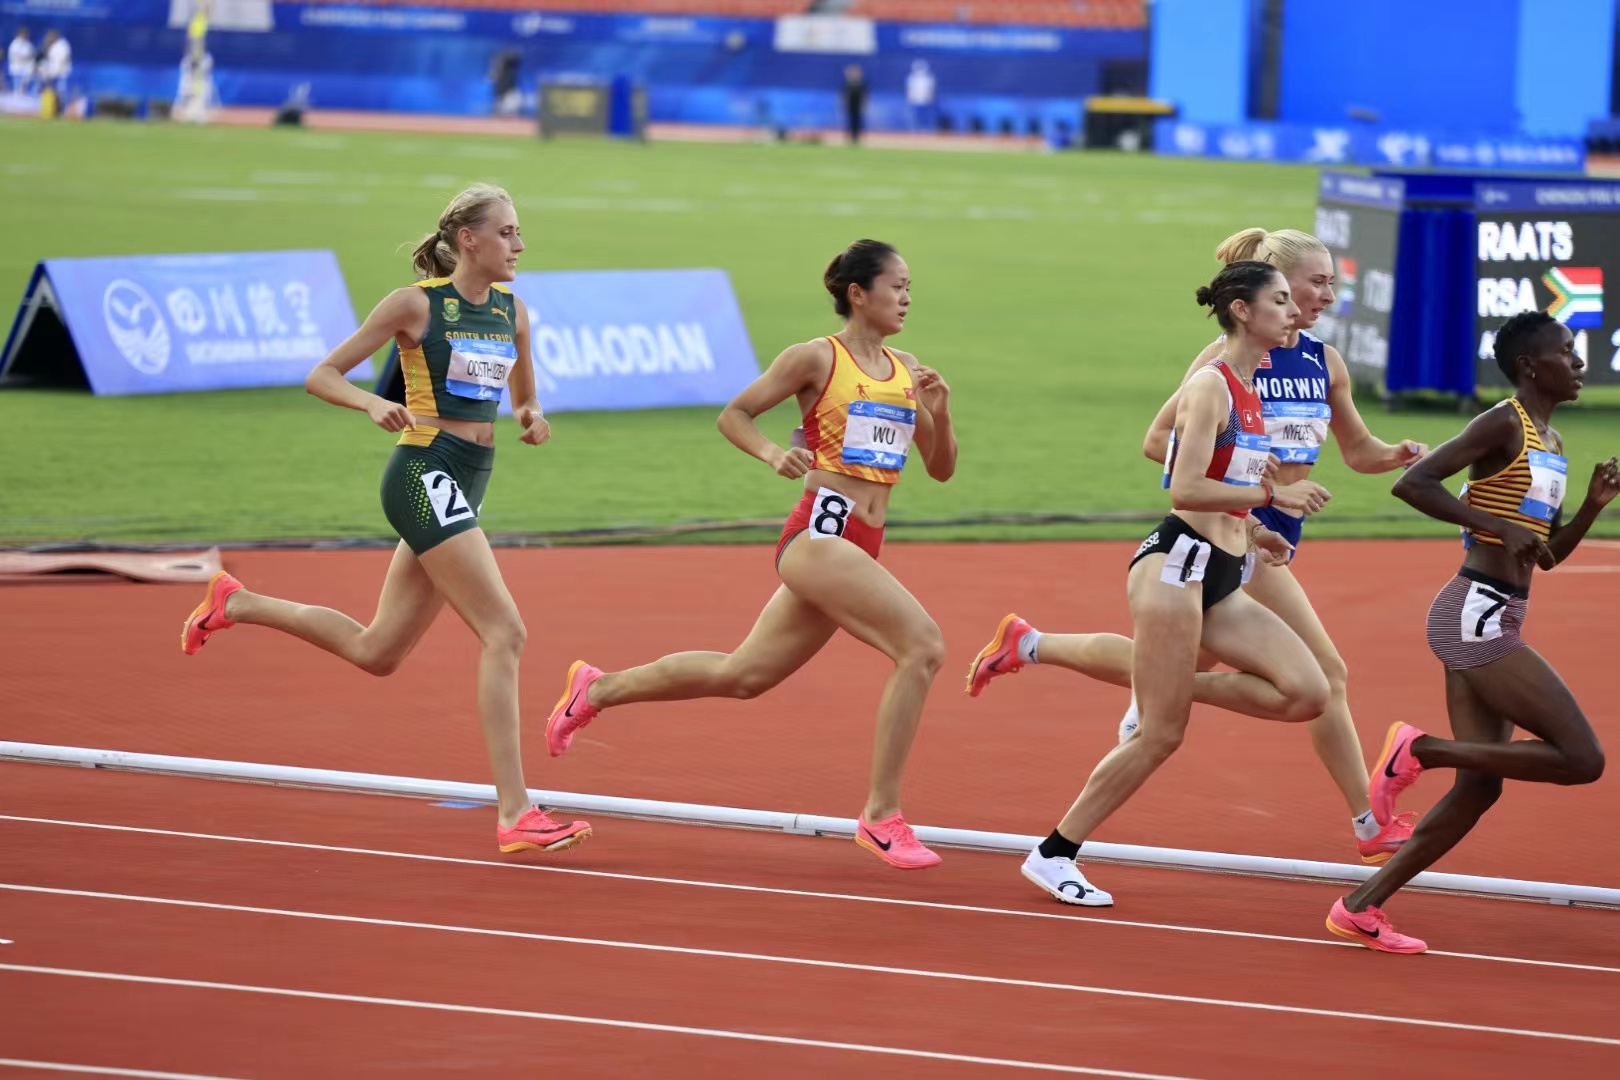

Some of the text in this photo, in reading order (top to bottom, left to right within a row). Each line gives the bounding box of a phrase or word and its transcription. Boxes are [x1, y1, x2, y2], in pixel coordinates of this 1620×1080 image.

[1477, 221, 1574, 261] RAATS
[1477, 277, 1539, 318] RSA
[535, 322, 715, 378] QIAODAN
[1255, 377, 1327, 400] NORWAY
[872, 425, 896, 446] WU
[432, 473, 470, 519] 2
[814, 494, 849, 537] 8
[1178, 542, 1201, 583] 1
[1475, 586, 1509, 638] 7
